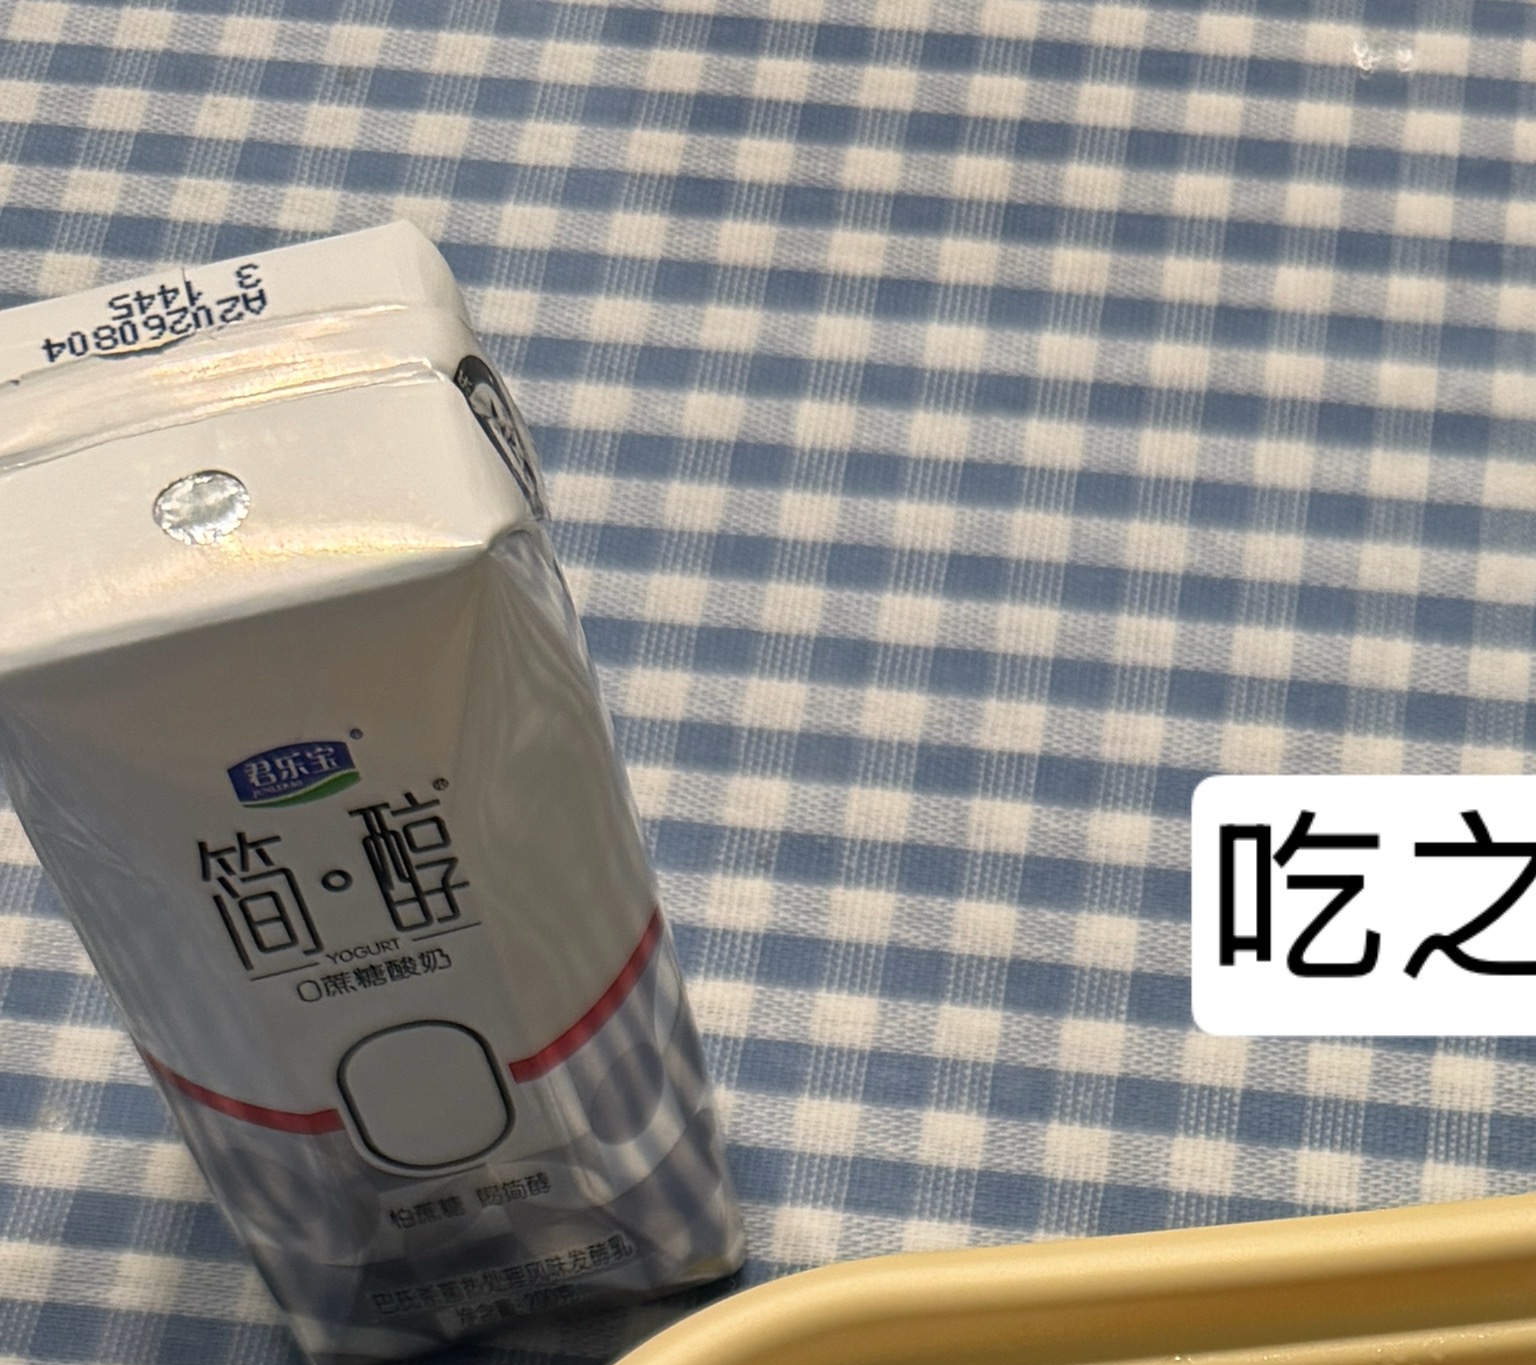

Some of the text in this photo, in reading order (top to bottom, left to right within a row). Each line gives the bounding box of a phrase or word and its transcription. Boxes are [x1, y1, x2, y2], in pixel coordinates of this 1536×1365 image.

[108, 280, 203, 321] 1445
[42, 288, 268, 363] A2U260804
[243, 746, 339, 788] 君乐宝
[325, 937, 402, 965] YOGURT
